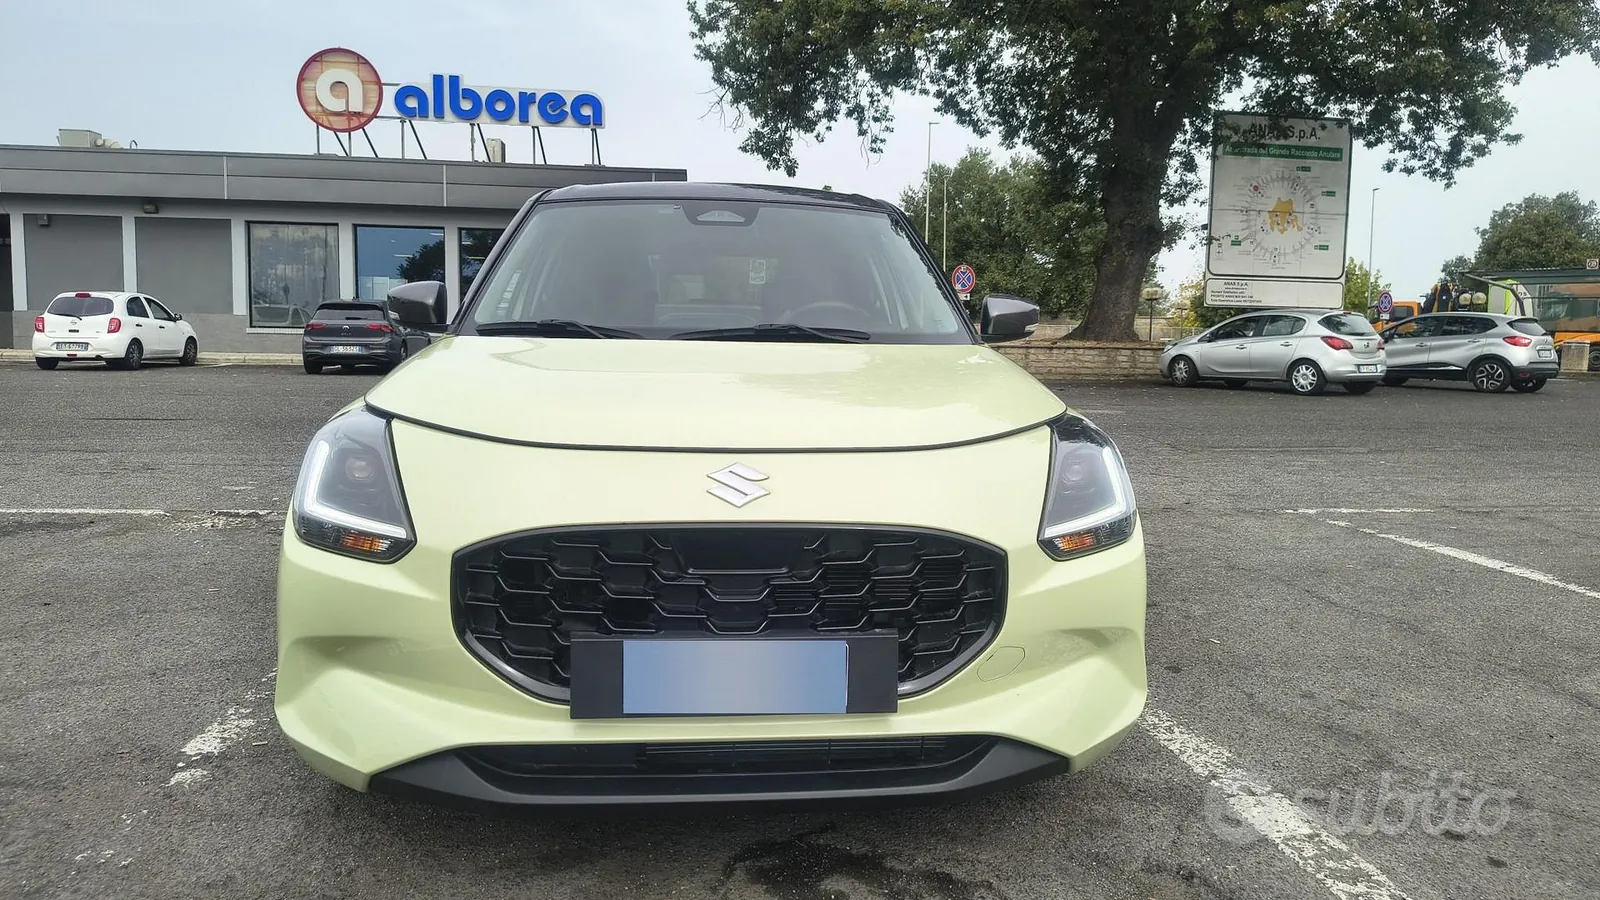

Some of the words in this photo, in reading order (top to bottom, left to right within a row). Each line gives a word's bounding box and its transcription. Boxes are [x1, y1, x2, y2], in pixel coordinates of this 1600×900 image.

[394, 73, 603, 126] alborea
[1287, 124, 1321, 142] S.p.A.
[1269, 147, 1289, 155] Grande
[1290, 148, 1318, 157] Raccordo
[1319, 150, 1341, 158] Anulare
